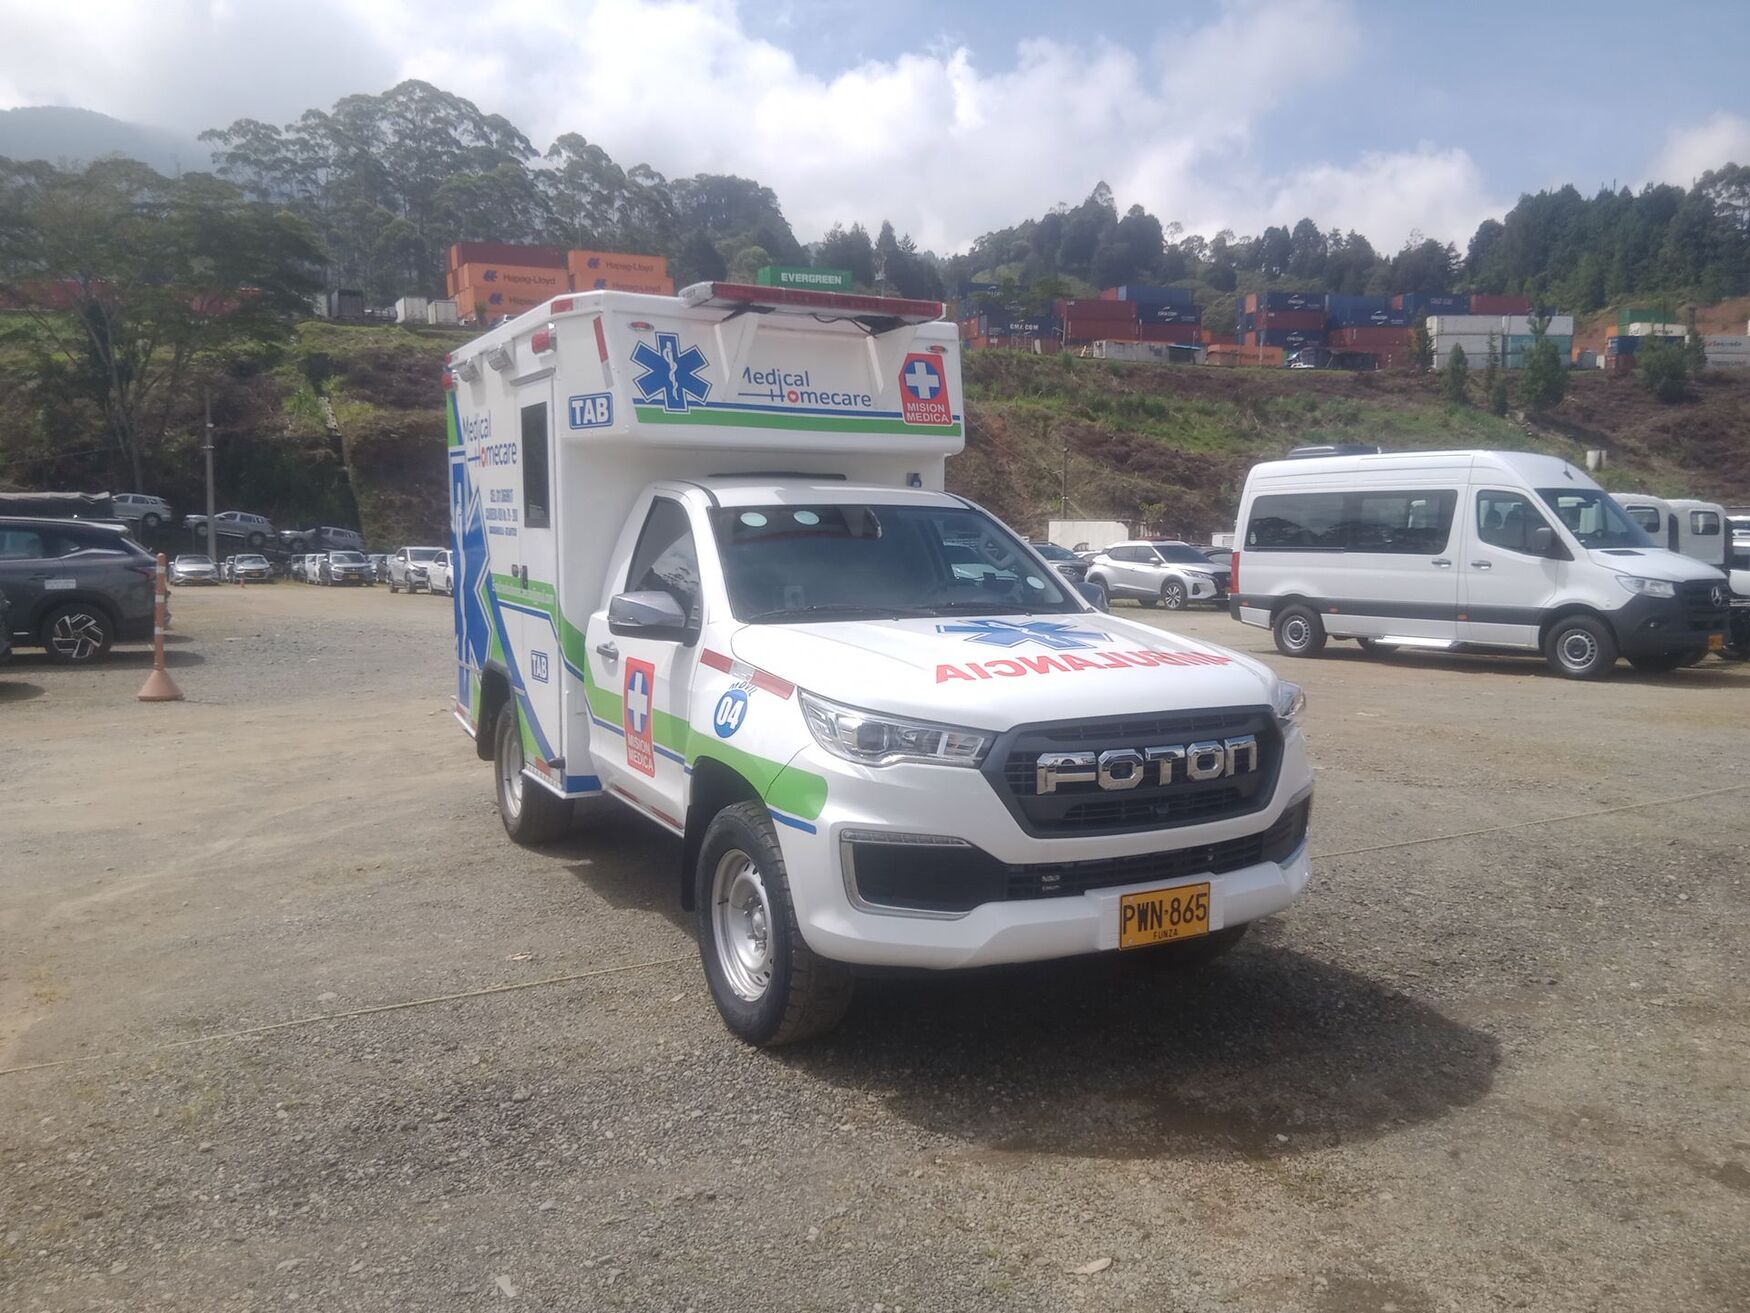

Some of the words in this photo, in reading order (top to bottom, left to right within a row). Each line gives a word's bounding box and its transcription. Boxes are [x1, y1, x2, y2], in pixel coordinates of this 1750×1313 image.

[606, 261, 654, 273] Hapag-Lloyd
[503, 273, 557, 285] Hapag-Lloyd
[781, 272, 842, 285] EVERGREEN
[770, 387, 872, 407] Homecare
[572, 397, 609, 425] TAB
[907, 402, 945, 414] MISION
[907, 411, 949, 423] MEDICA
[462, 409, 491, 442] Medical
[475, 441, 518, 468] Homecare
[532, 654, 548, 680] TAB
[716, 696, 744, 730] 04
[627, 733, 650, 753] MISION
[628, 747, 653, 770] MEDICA
[1036, 734, 1257, 796] FOTON
[1153, 928, 1178, 940] FUNZA
